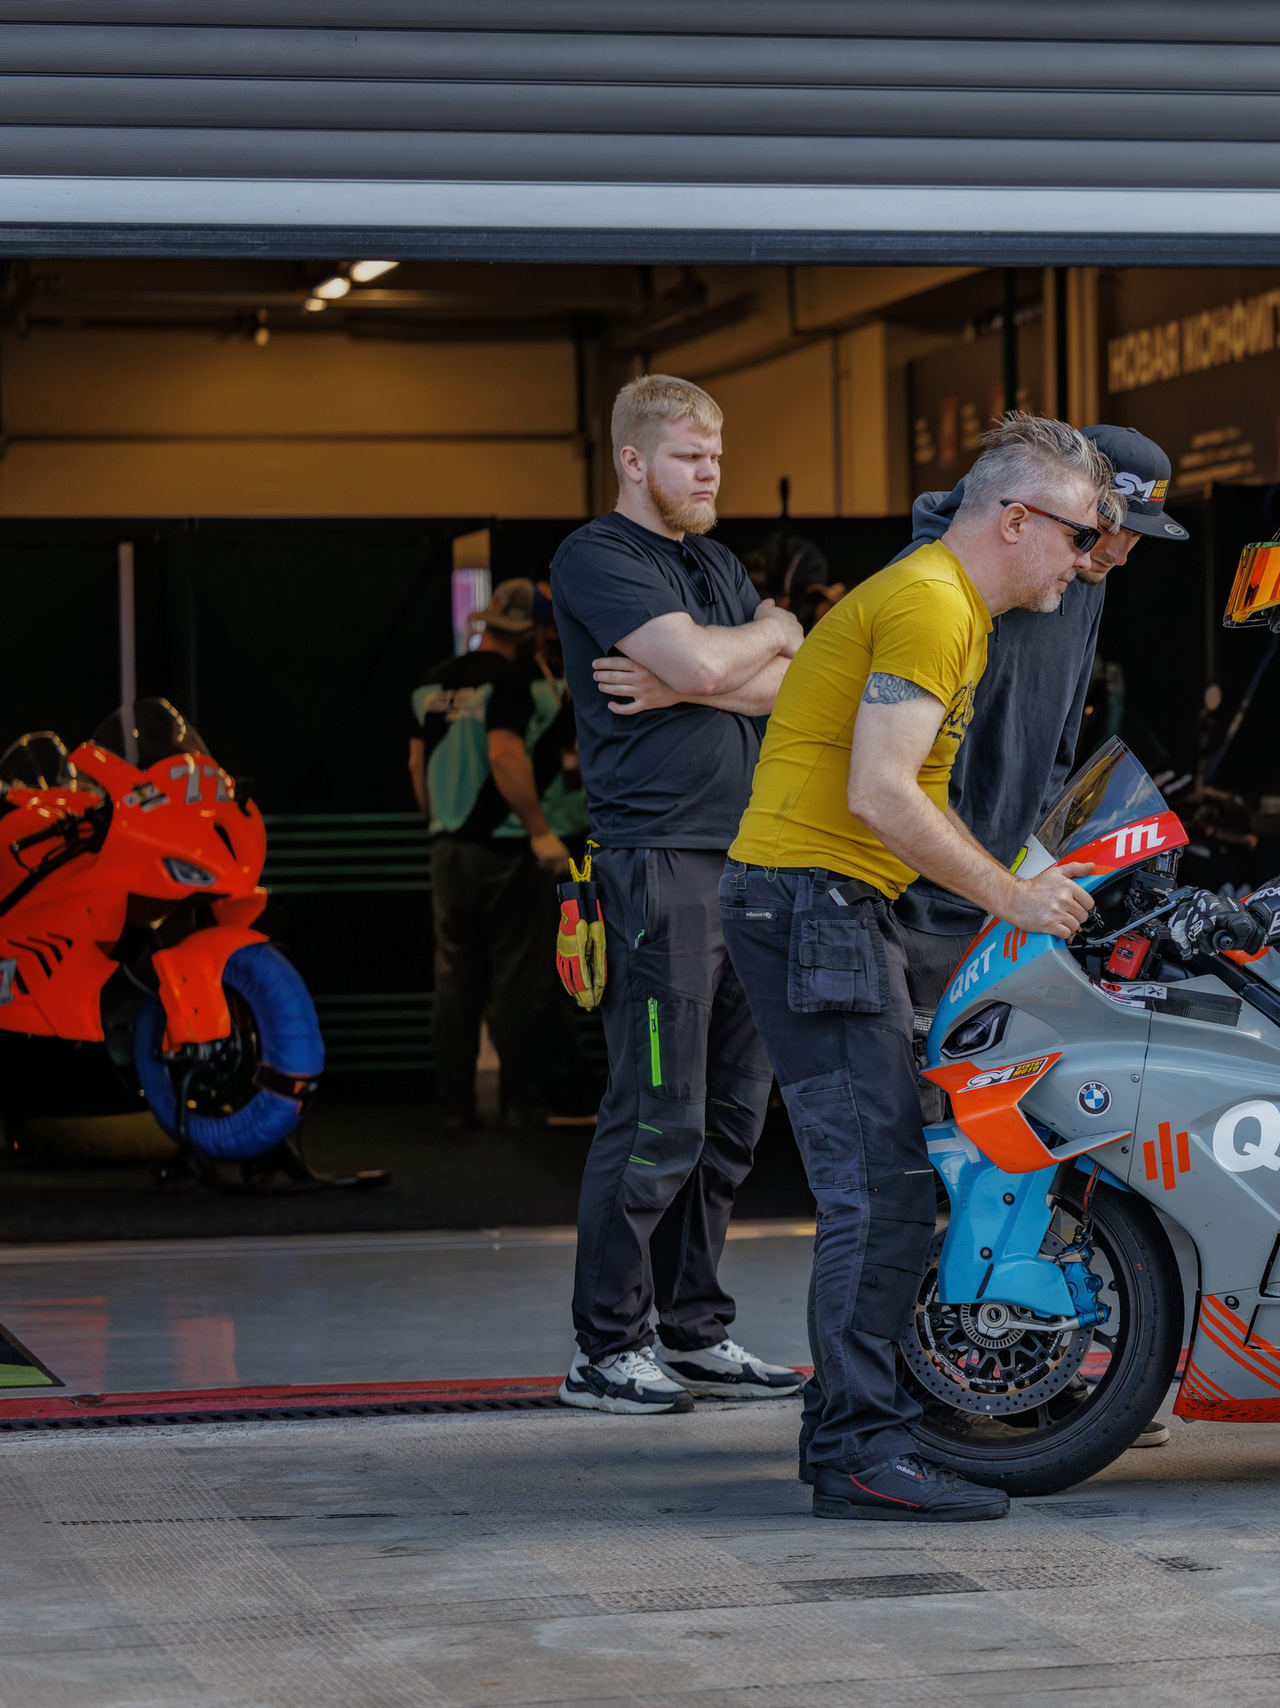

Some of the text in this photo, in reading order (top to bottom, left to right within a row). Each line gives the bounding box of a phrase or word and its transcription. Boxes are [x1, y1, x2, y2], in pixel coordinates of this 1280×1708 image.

[1108, 321, 1180, 394] НОВАЯ
[949, 941, 997, 1004] QRT
[1012, 1066, 1039, 1077] MOTO
[1080, 1083, 1107, 1095] BMW
[896, 1464, 916, 1477] adidas
